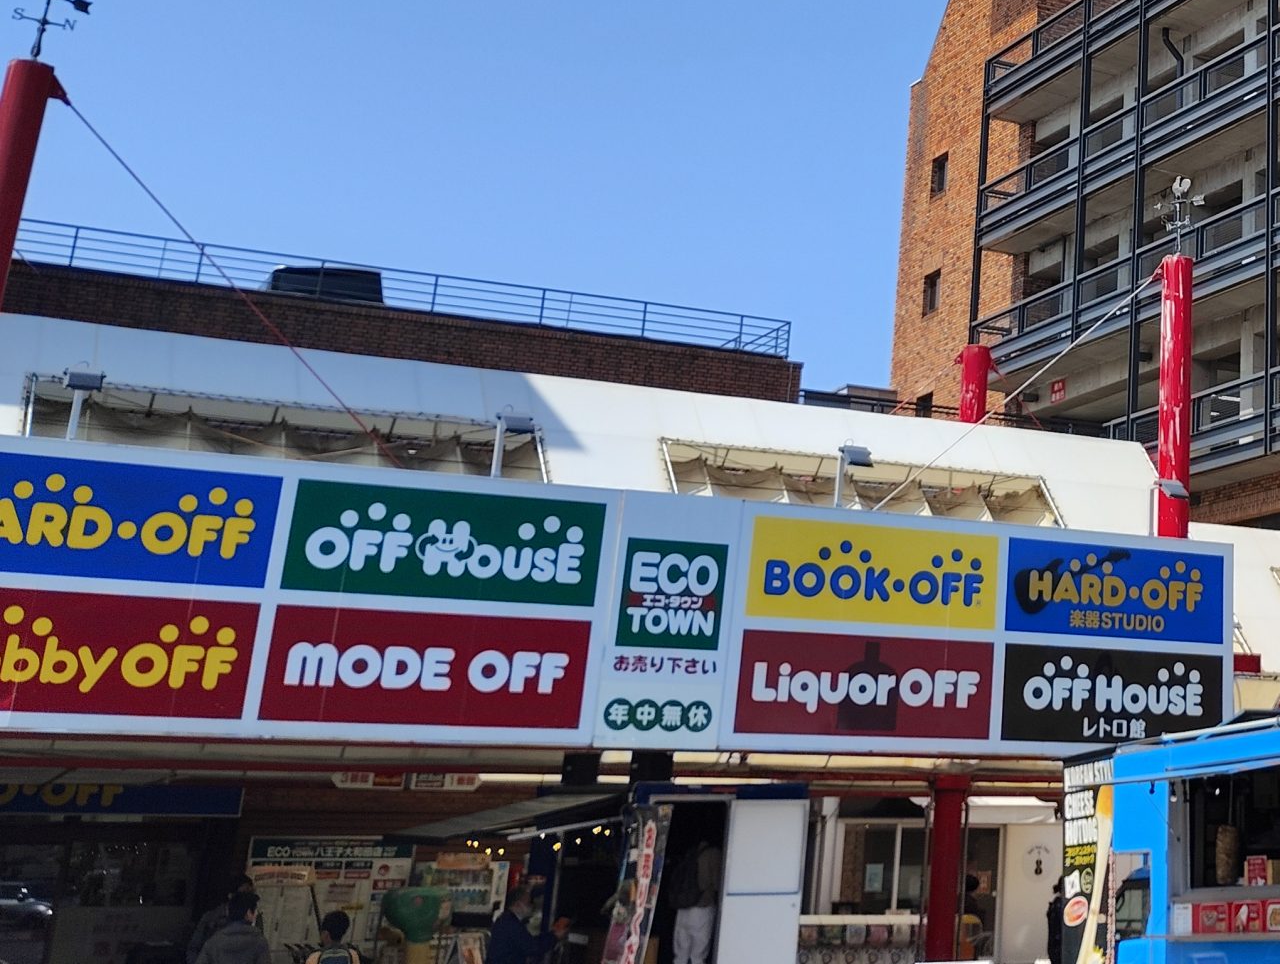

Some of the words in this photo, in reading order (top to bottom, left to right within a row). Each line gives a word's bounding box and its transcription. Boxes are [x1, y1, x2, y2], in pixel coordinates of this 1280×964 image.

[305, 526, 414, 574] OFF
[629, 551, 719, 596] ECO
[641, 594, 703, 609] エコ・タウン
[626, 607, 715, 636] TOWN
[0, 633, 118, 694] bby
[120, 642, 239, 691] OFF
[283, 641, 456, 692] MODE
[467, 649, 570, 695] OFF
[613, 654, 718, 675] お売り下さい
[751, 661, 897, 714] Liquor
[898, 667, 981, 709] OFF
[1022, 675, 1092, 712] OFF
[607, 703, 709, 728] 年中無休
[1082, 716, 1147, 739] レトロ館
[266, 846, 291, 858] ECO
